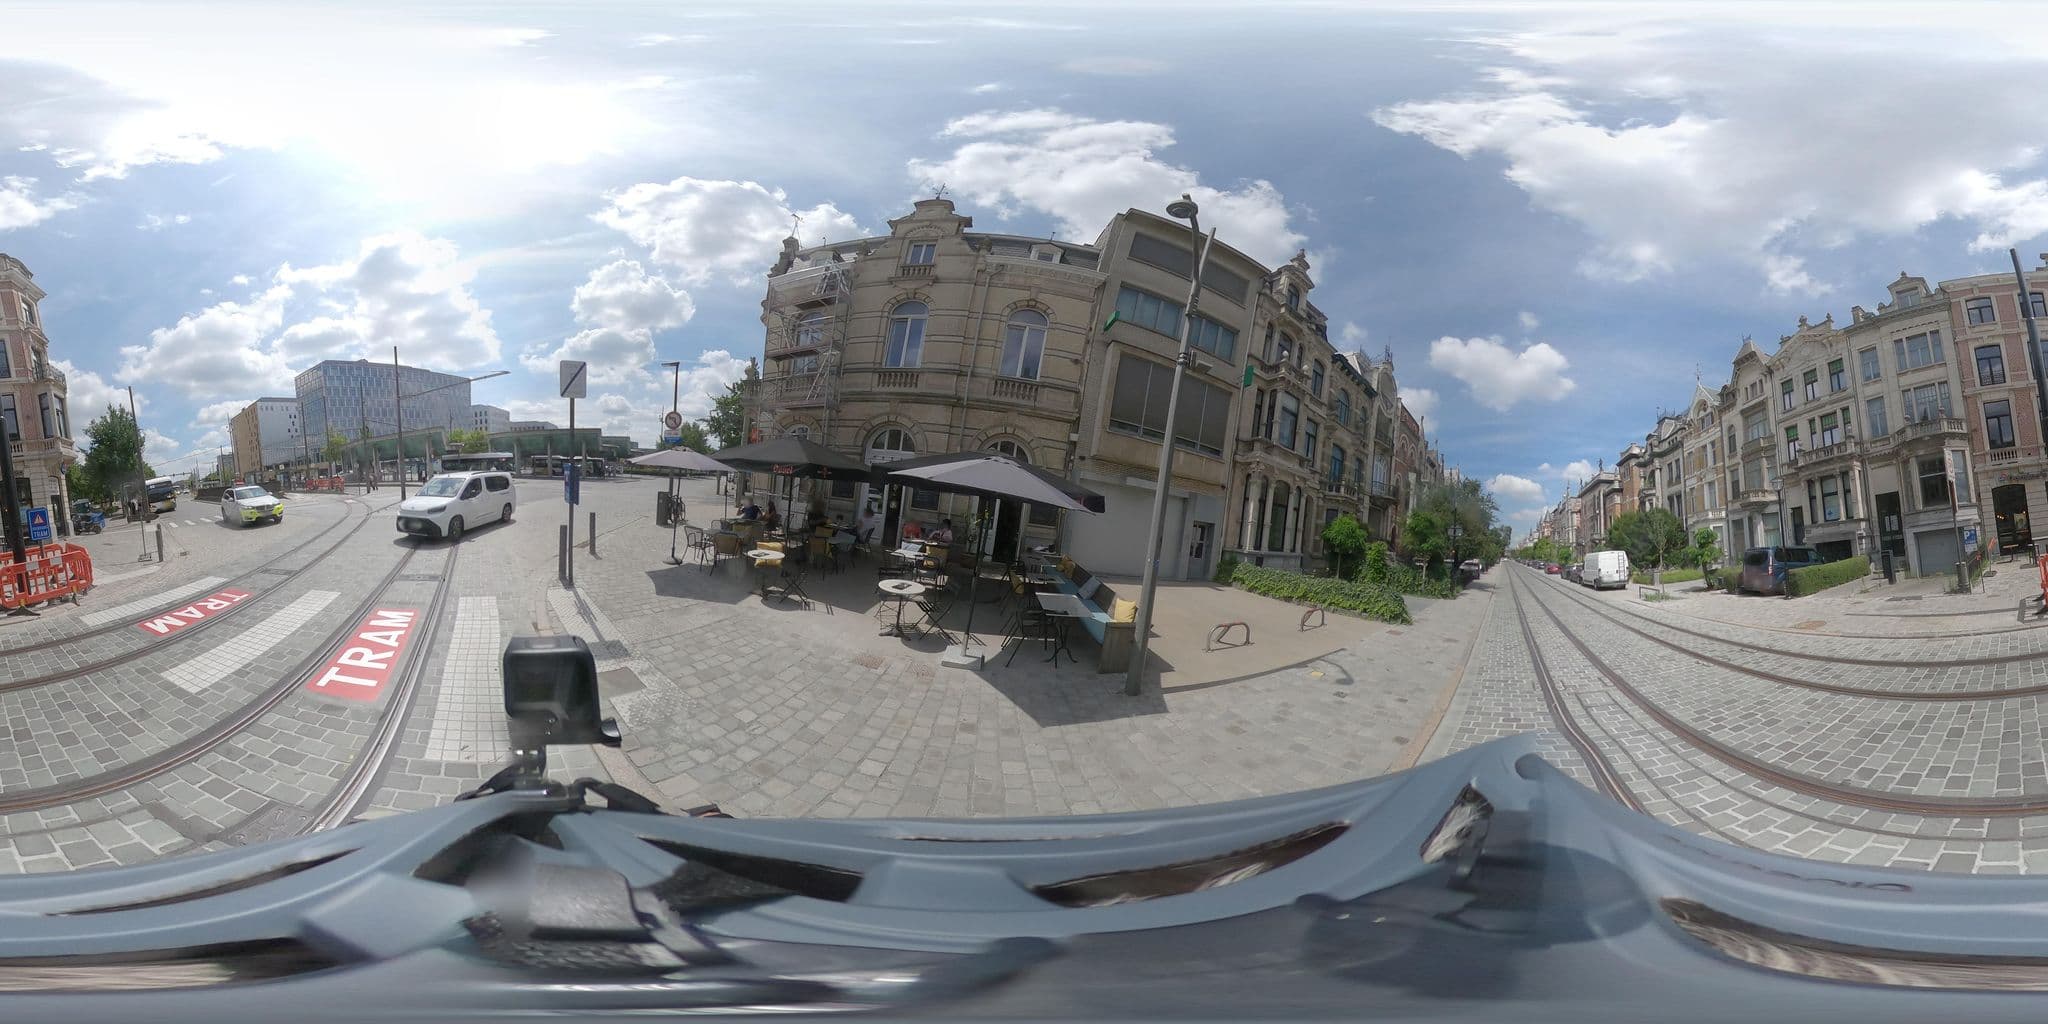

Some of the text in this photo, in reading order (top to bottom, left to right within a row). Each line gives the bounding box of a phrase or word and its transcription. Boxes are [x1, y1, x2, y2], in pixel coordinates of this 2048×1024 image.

[33, 529, 48, 538] TRAM
[144, 592, 248, 634] TRAM
[316, 610, 414, 687] TRAM
